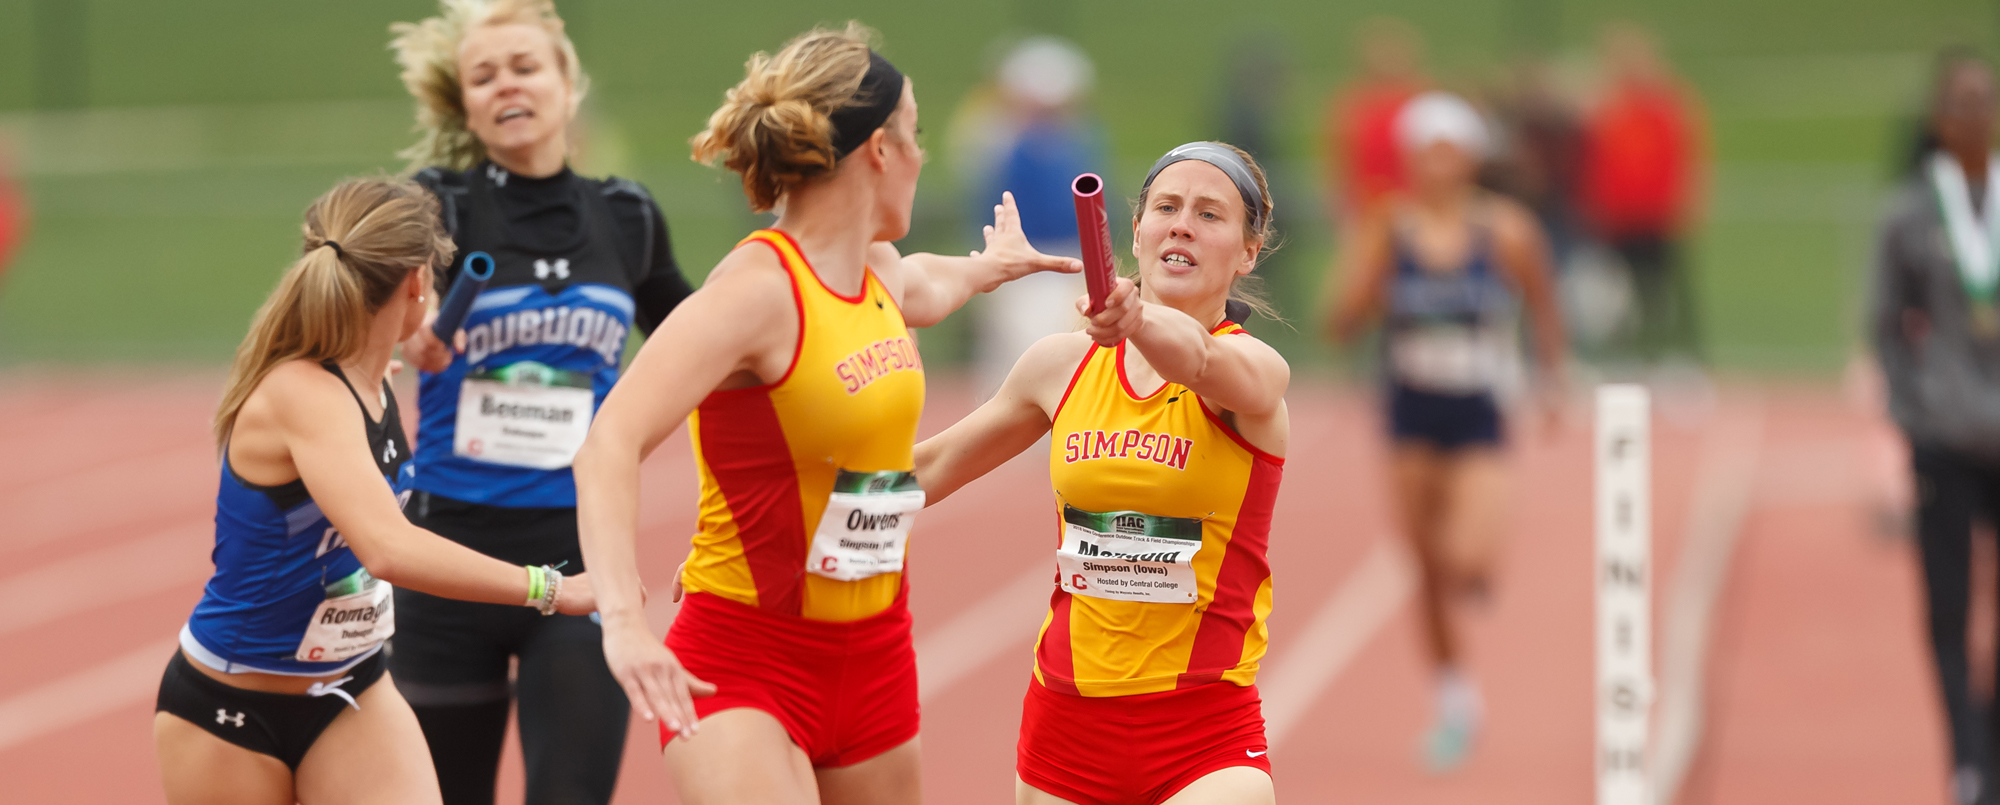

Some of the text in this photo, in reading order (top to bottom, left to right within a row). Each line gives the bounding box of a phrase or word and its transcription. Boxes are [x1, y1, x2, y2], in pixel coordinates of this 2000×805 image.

[1065, 429, 1194, 471] SIMPSON
[1162, 539, 1195, 547] Championships
[1083, 562, 1168, 576] Simpson (Iowa)
[1097, 578, 1178, 589] Hosted by Central College
